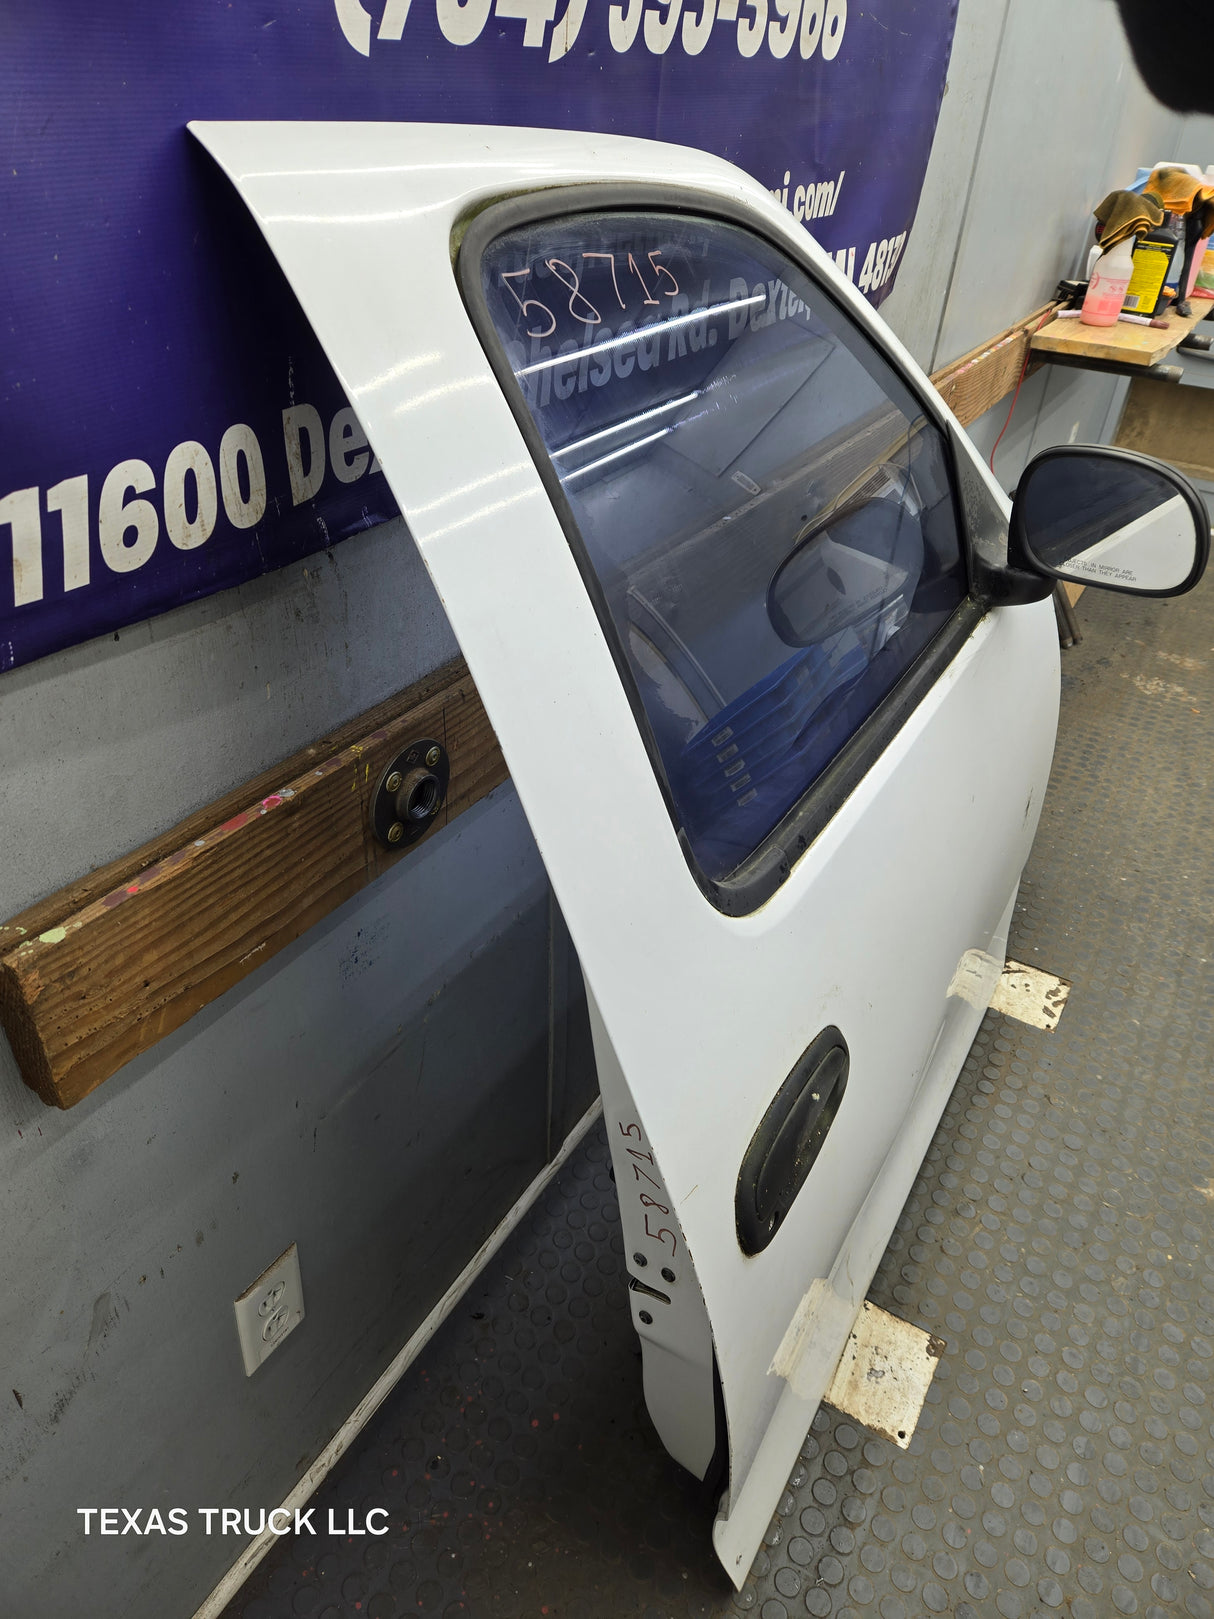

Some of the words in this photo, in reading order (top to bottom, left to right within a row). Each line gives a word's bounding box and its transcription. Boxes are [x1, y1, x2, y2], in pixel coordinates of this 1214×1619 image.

[501, 250, 680, 340] 58715
[0, 423, 267, 607] 11600
[282, 402, 384, 506] De
[618, 1121, 677, 1257] 58715
